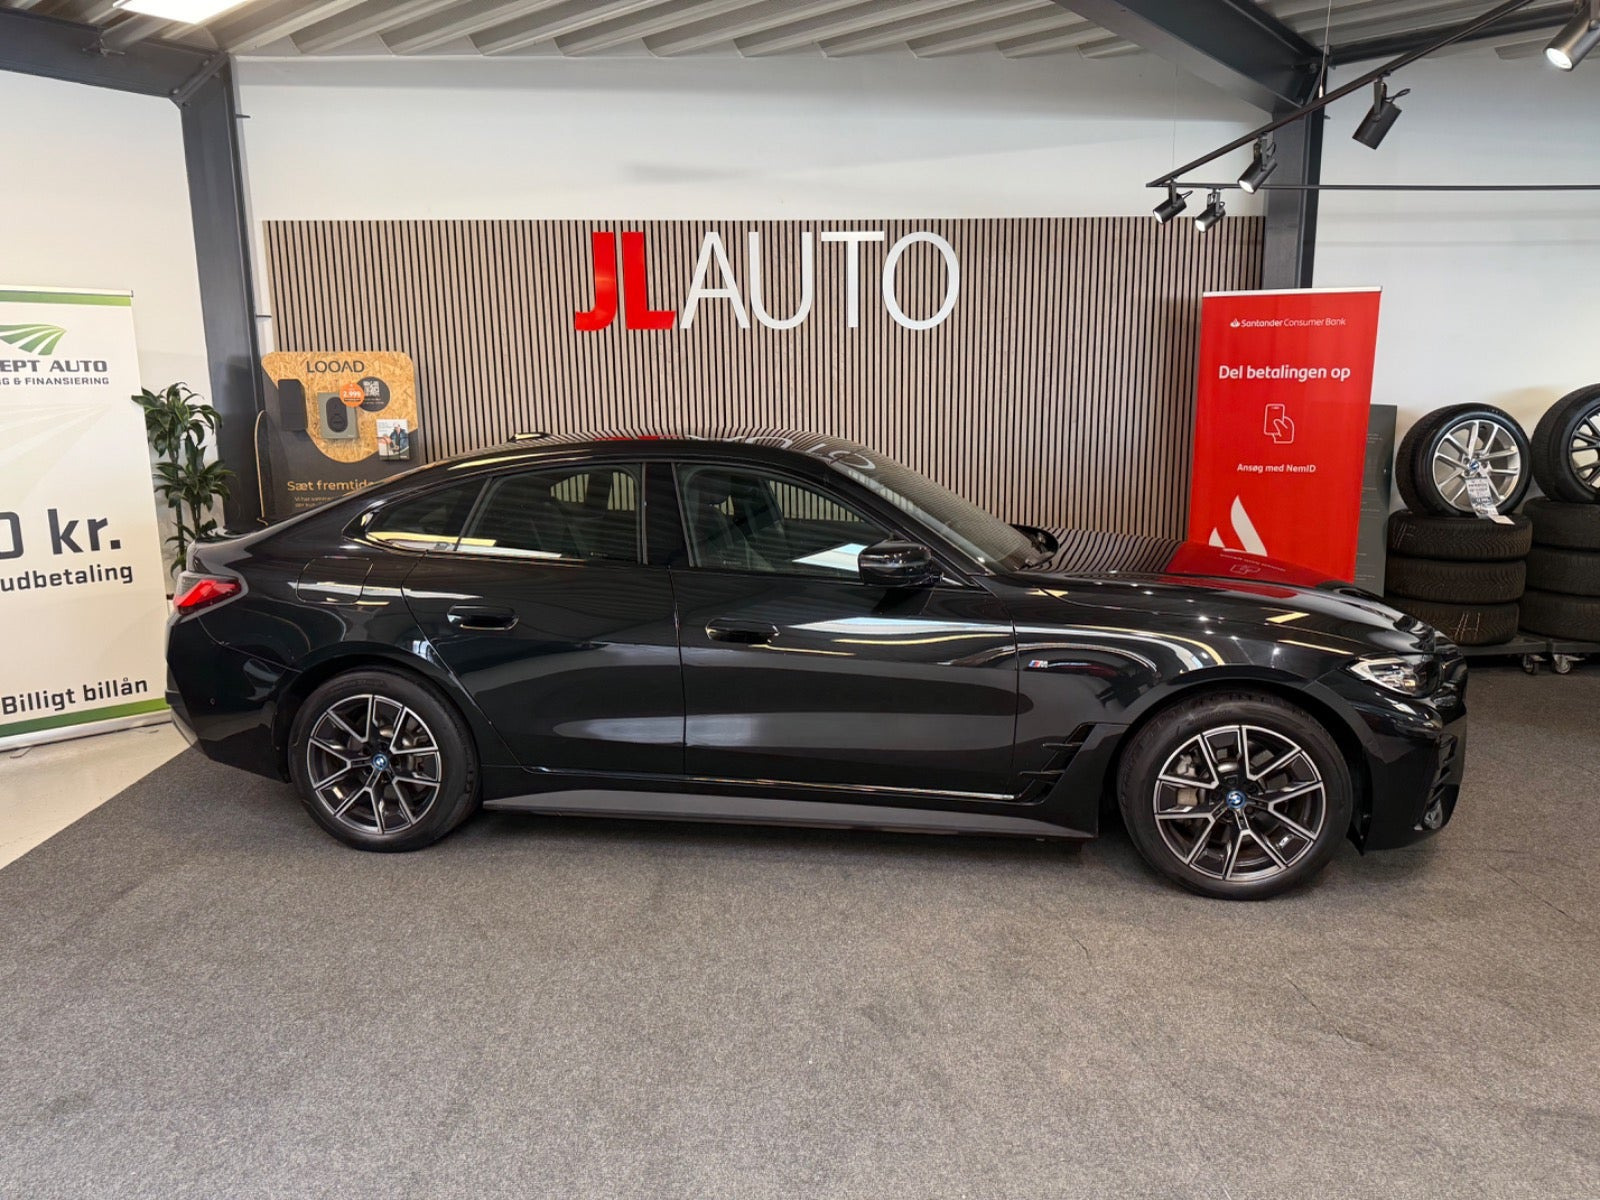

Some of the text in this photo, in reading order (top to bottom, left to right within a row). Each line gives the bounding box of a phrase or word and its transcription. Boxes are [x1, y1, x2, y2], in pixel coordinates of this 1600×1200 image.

[1241, 317, 1346, 327] Santander Consumer Bank
[0, 360, 107, 372] EPT AUTO
[306, 361, 365, 373] LOOAD
[1219, 365, 1351, 382] Del betalingen op
[0, 377, 10, 385] G
[25, 377, 109, 385] FINANSIERING
[1237, 464, 1263, 473] Ansøg
[1265, 464, 1284, 472] med
[287, 481, 314, 491] Sæt
[48, 508, 121, 555] kr.
[0, 564, 133, 592] udbetaling
[1, 677, 148, 715] Billigt billån
